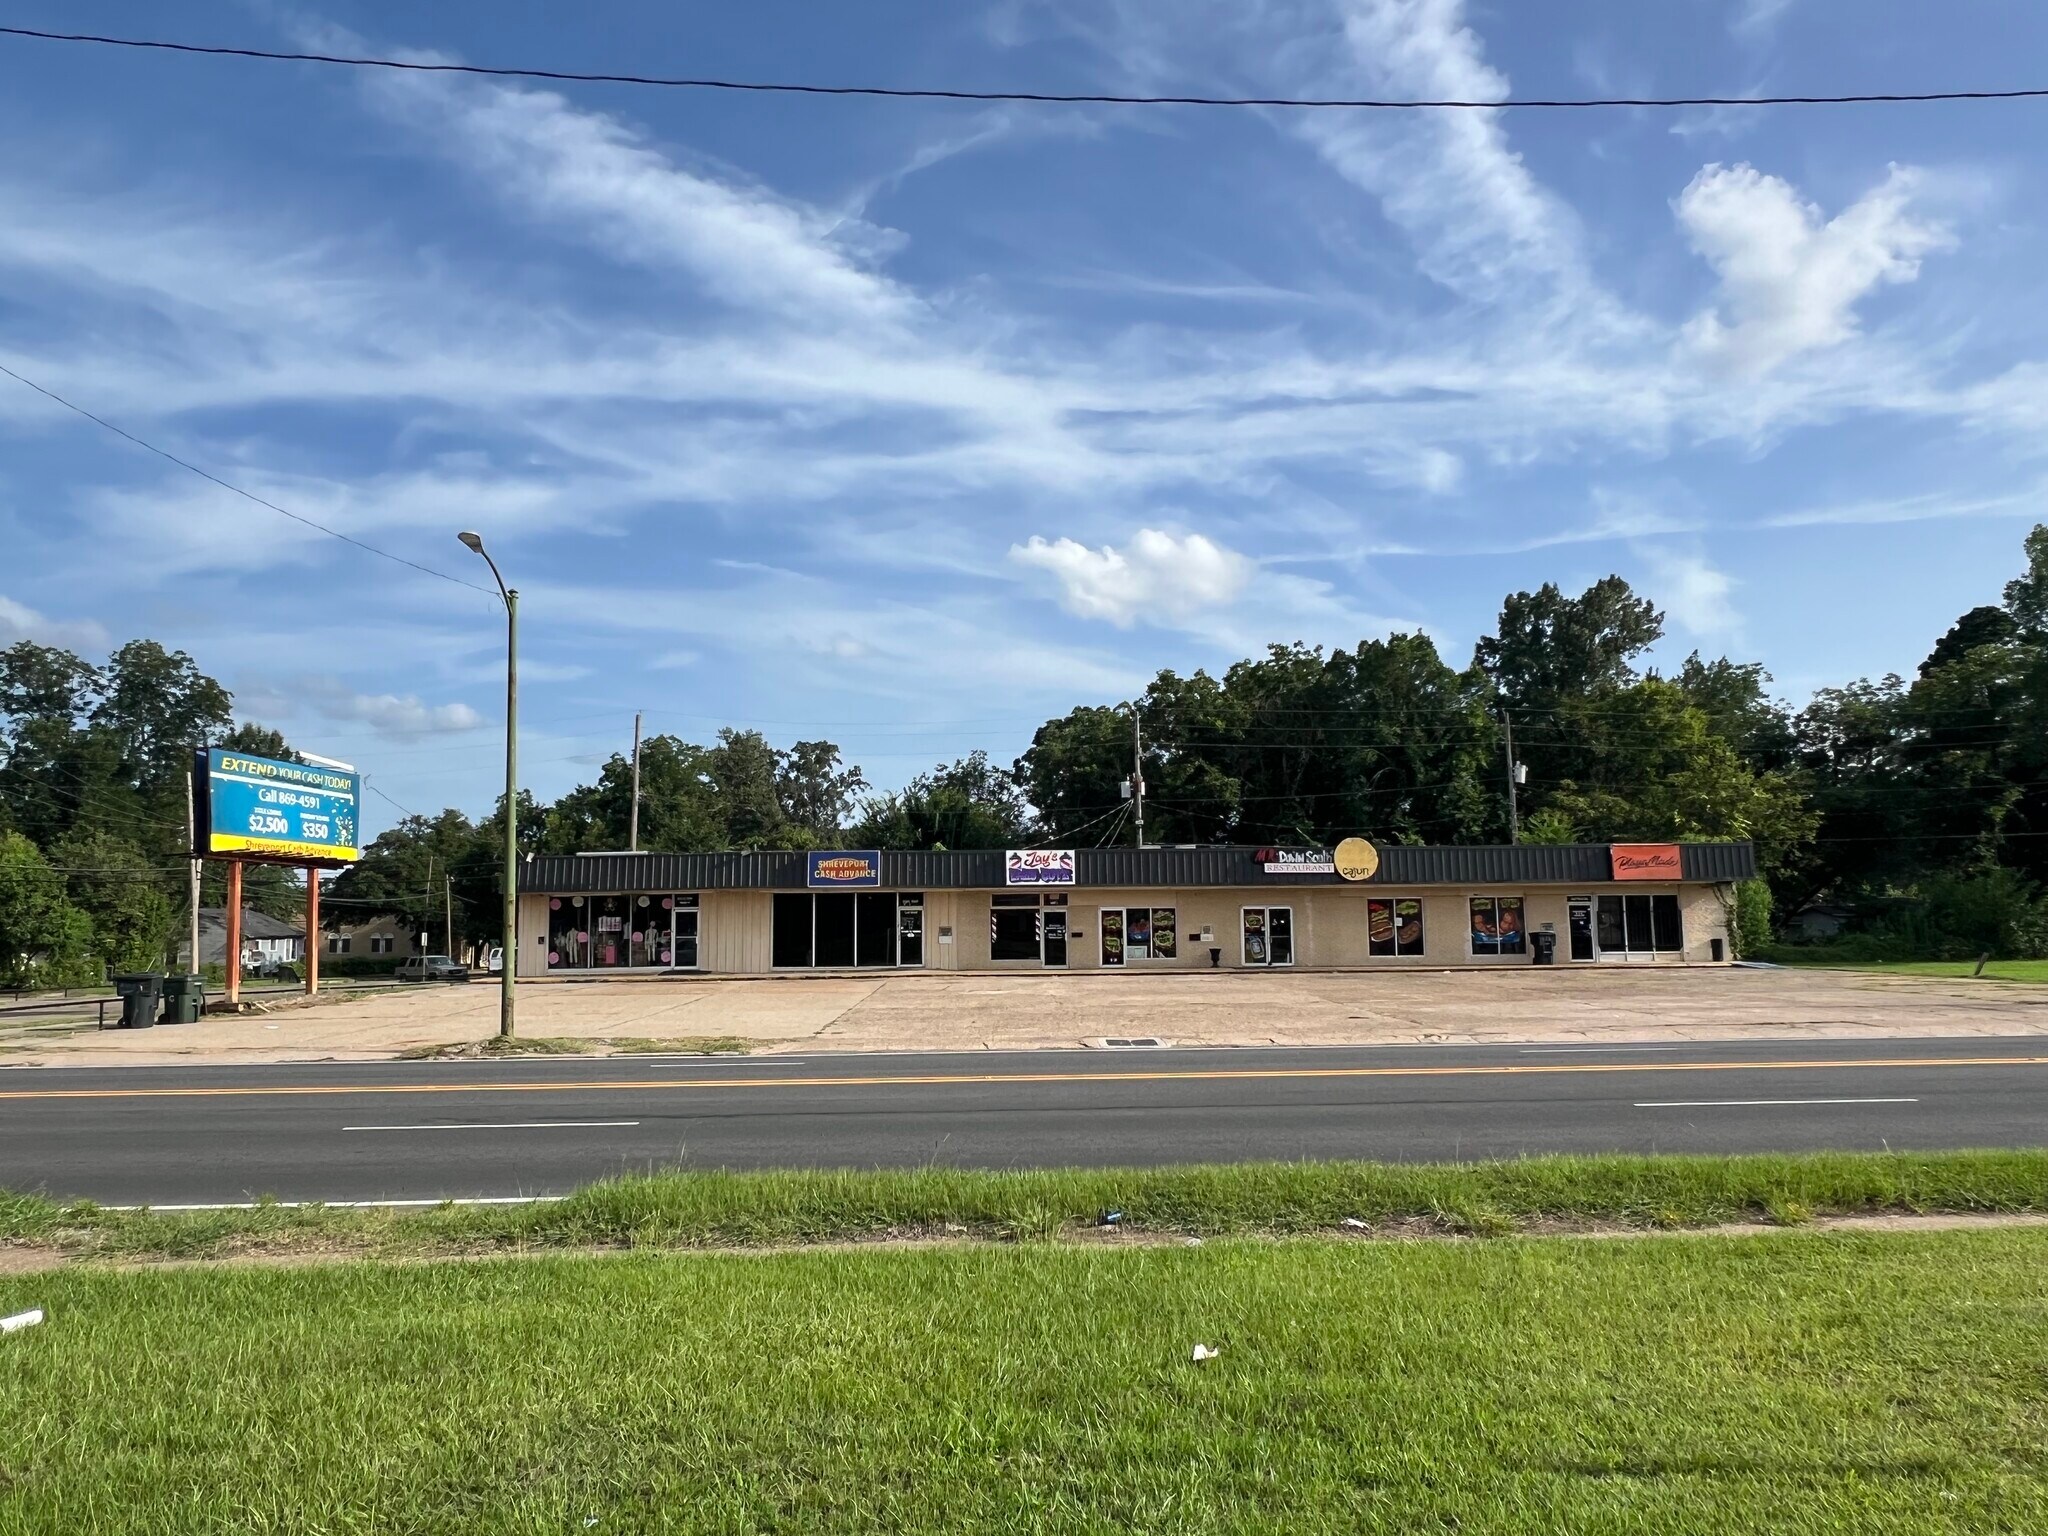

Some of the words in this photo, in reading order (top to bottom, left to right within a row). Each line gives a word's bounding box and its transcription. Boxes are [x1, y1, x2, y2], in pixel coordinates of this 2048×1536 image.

[221, 757, 277, 777] EXTEND
[279, 767, 301, 780] YOUR
[302, 771, 324, 785] CASH
[323, 777, 352, 790] TODAY!
[258, 788, 277, 803] Call
[278, 792, 320, 808] 869-4591
[249, 814, 289, 834] $2,500
[302, 821, 329, 839] $350
[245, 839, 286, 852] Shreveport
[817, 860, 869, 869] SHREVEPORT
[1265, 864, 1333, 872] RESTAURANT
[814, 870, 836, 878] CASH
[838, 869, 877, 878] ADVANCE
[1342, 866, 1369, 878] cajun
